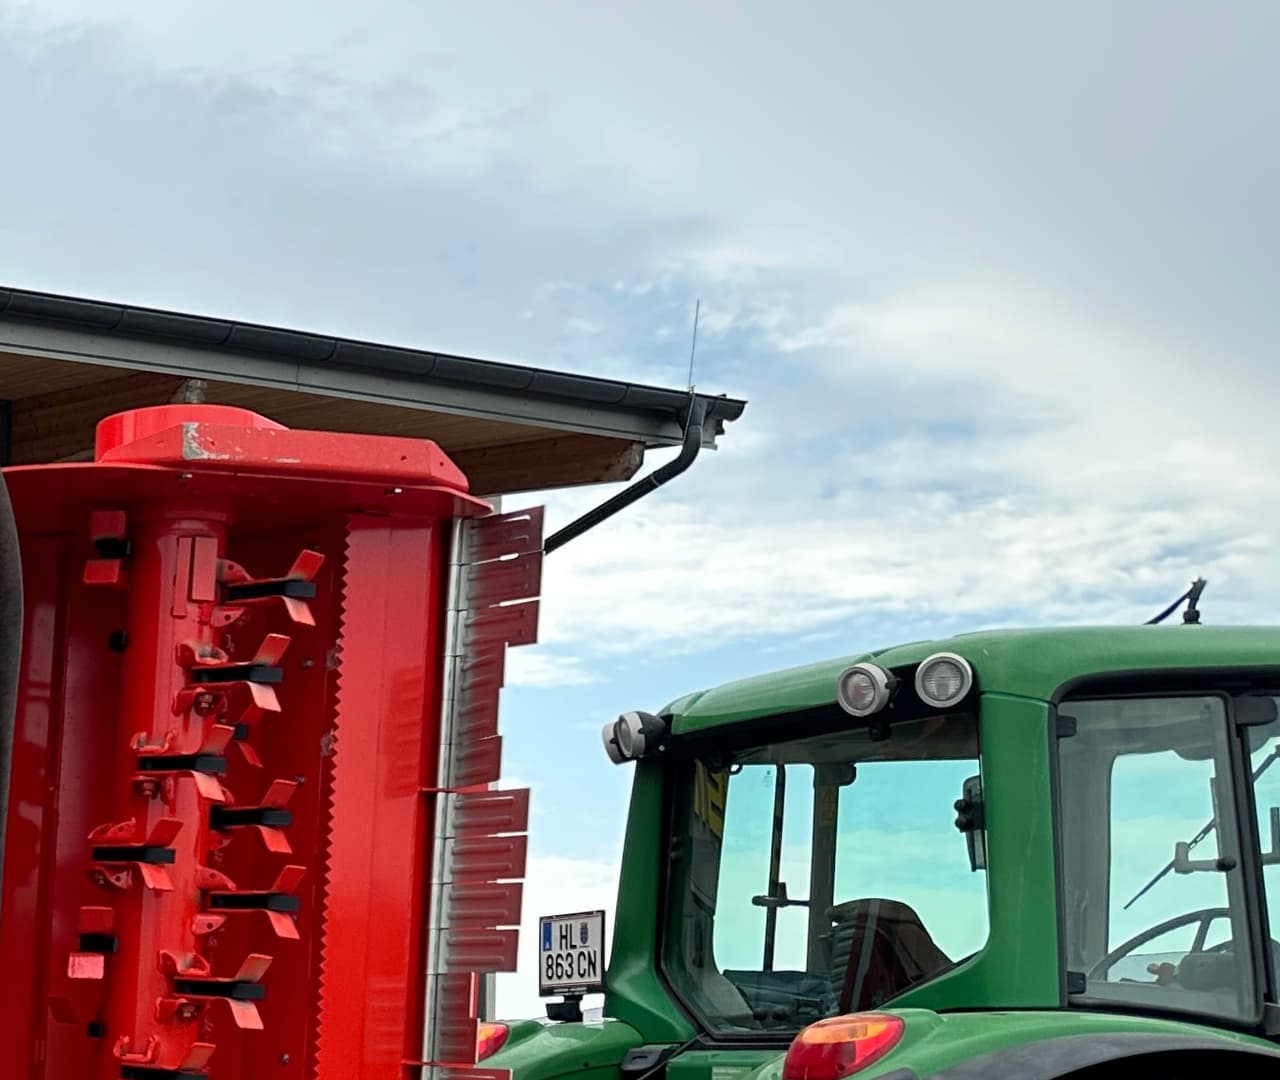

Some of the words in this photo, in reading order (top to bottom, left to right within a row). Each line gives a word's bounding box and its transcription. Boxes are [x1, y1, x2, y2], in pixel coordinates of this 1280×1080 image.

[559, 922, 578, 950] HL
[545, 952, 574, 980] 863
[577, 950, 597, 978] CN
